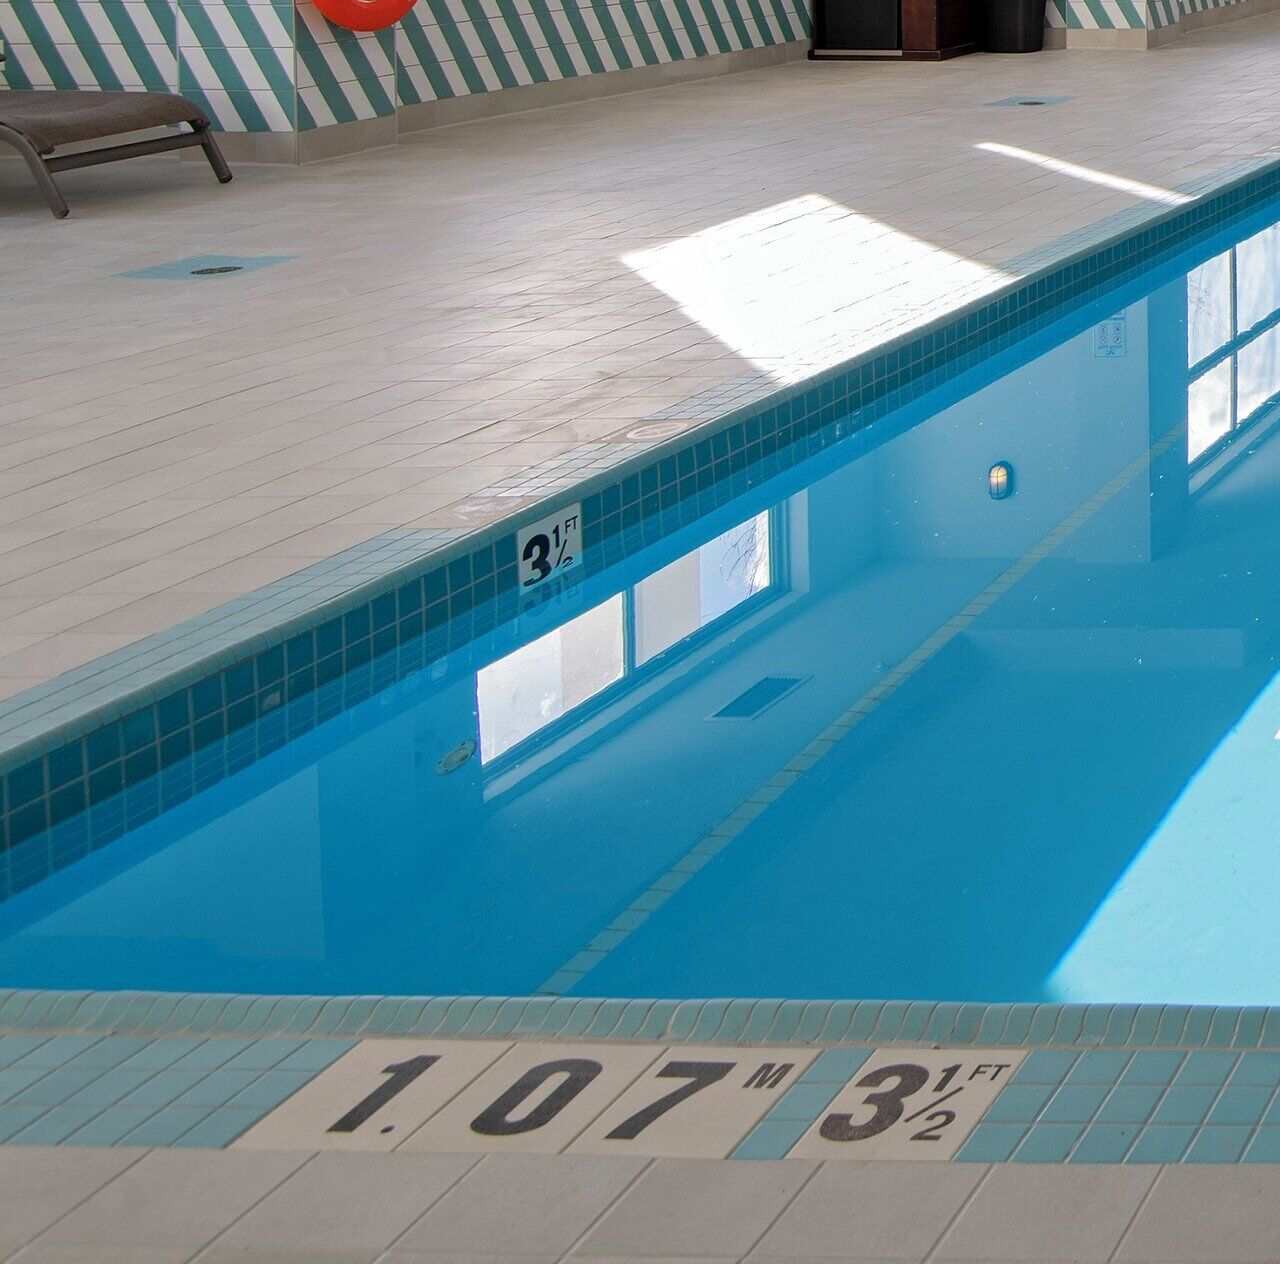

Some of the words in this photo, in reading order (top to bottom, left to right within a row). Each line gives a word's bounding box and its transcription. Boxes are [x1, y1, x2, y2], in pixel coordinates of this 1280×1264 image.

[565, 515, 578, 534] FT
[742, 1063, 796, 1089] M
[819, 1063, 930, 1142] 3
[967, 1063, 1011, 1081] FT
